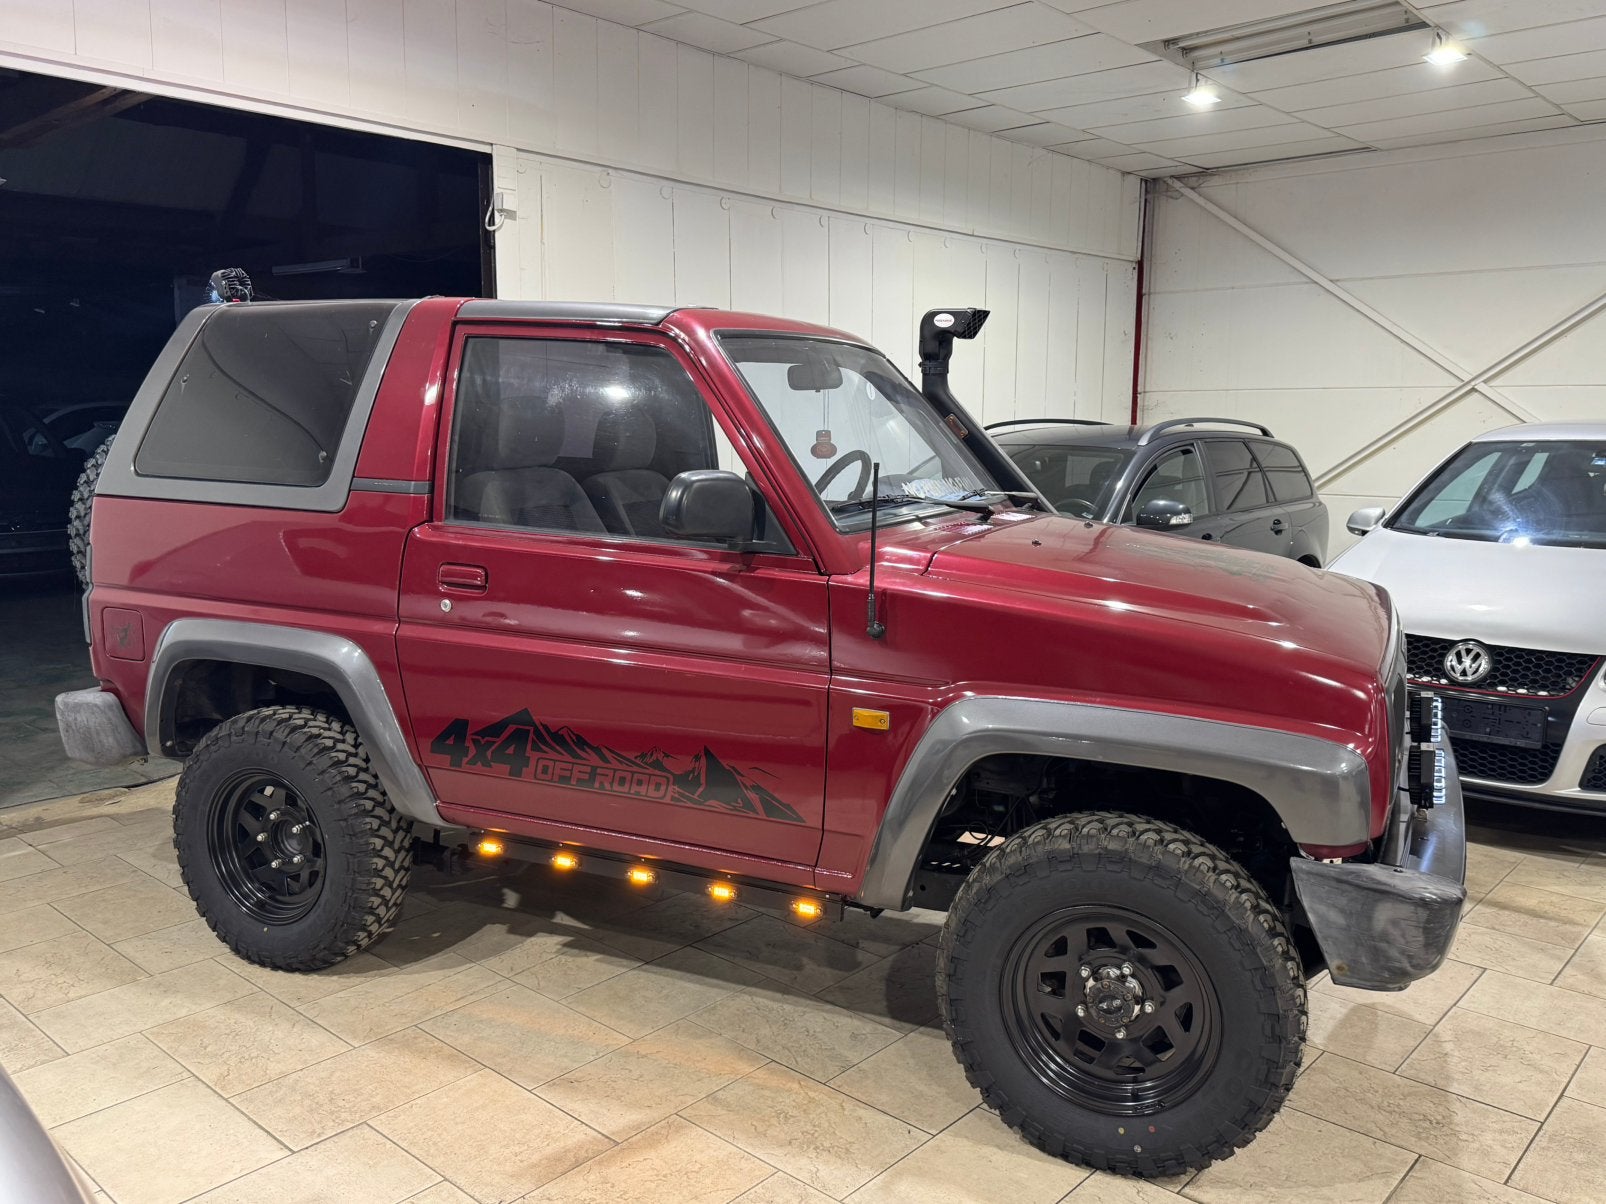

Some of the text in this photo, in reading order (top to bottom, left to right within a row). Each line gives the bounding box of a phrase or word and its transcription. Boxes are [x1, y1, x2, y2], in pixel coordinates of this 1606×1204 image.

[1445, 642, 1491, 682] VW
[430, 718, 534, 778] 4x4
[537, 759, 670, 799] OFF ROAD
